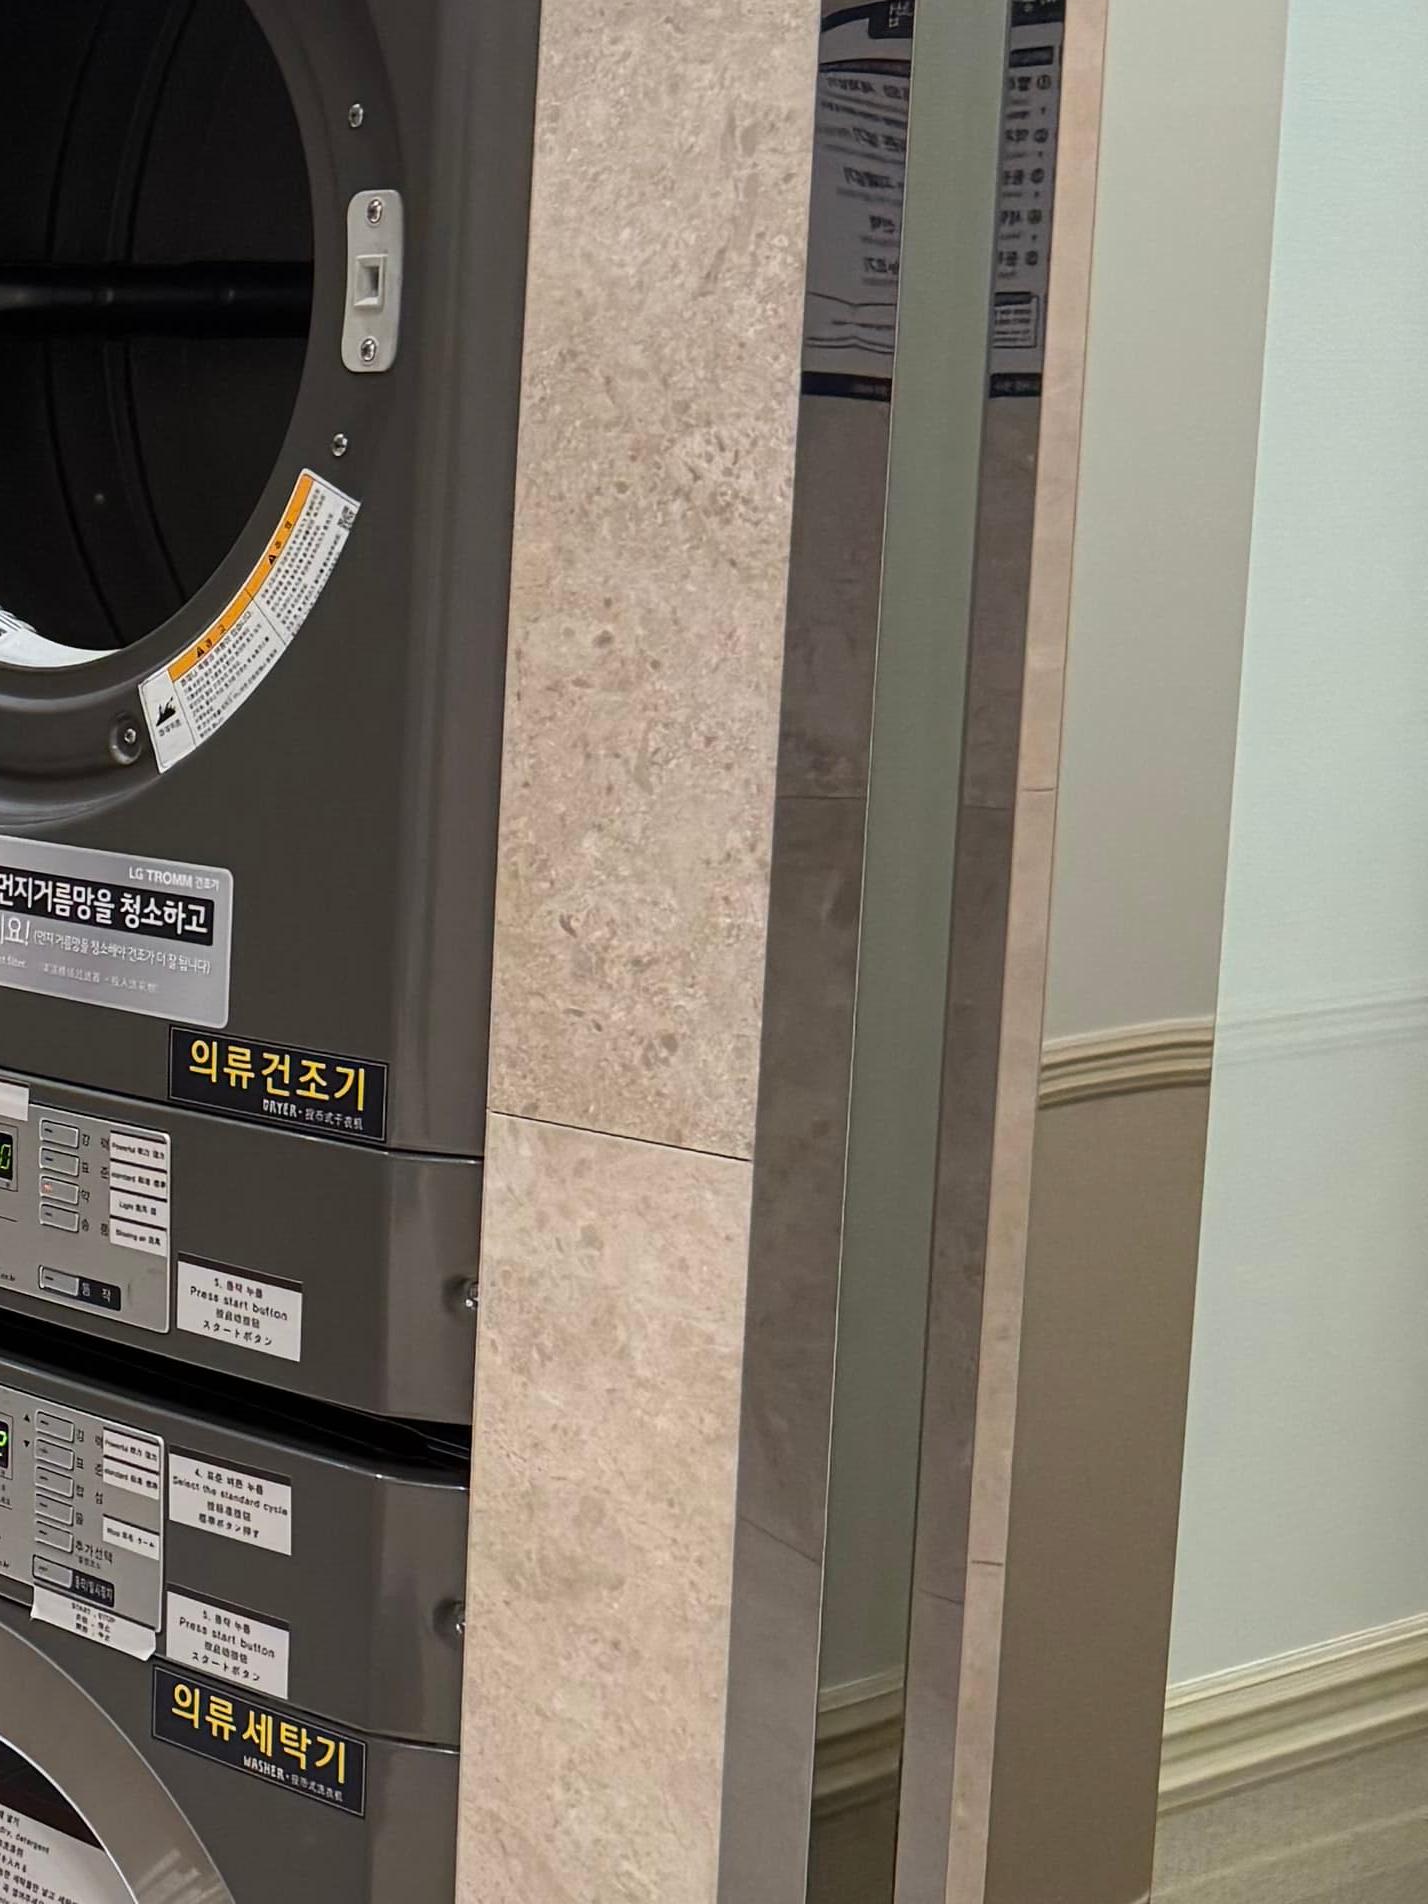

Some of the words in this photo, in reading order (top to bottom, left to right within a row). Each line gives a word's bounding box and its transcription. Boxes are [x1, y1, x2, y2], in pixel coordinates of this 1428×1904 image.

[128, 866, 143, 880] LG
[147, 868, 193, 889] TROMM
[195, 876, 220, 892] 건조기
[120, 893, 209, 935] 청소하고
[34, 930, 56, 947] (먼지
[56, 933, 90, 954] 거름망을
[91, 940, 128, 960] 청소해야
[128, 946, 155, 965] 건조가
[156, 951, 166, 966] 더
[189, 1039, 365, 1112] 의류건조기
[190, 1285, 219, 1303] Press
[224, 1296, 248, 1312] start
[252, 1302, 288, 1322] button
[214, 1278, 222, 1289] 5.
[227, 1280, 243, 1294] 동작
[247, 1286, 263, 1299] 누름
[203, 1319, 272, 1346] スタートボタン
[172, 1474, 200, 1492] Select
[202, 1483, 217, 1497] the
[220, 1488, 260, 1509] standard
[263, 1502, 288, 1518] cycle
[207, 1470, 222, 1483] 표준
[226, 1475, 243, 1490] 버튼
[247, 1481, 263, 1496] 누름
[179, 1614, 206, 1636] Press
[211, 1628, 235, 1645] start
[239, 1636, 275, 1658] button
[214, 1613, 230, 1628] 동작
[234, 1620, 250, 1635] 누름
[191, 1650, 260, 1683] スタートボタン
[171, 1683, 346, 1785] 의류세탁기
[243, 1754, 285, 1782] WASHER
[6, 1812, 20, 1829] 넣기
[15, 1830, 50, 1858] detergent
[12, 1872, 39, 1896] 세탁물만
[41, 1885, 55, 1903] 넣고
